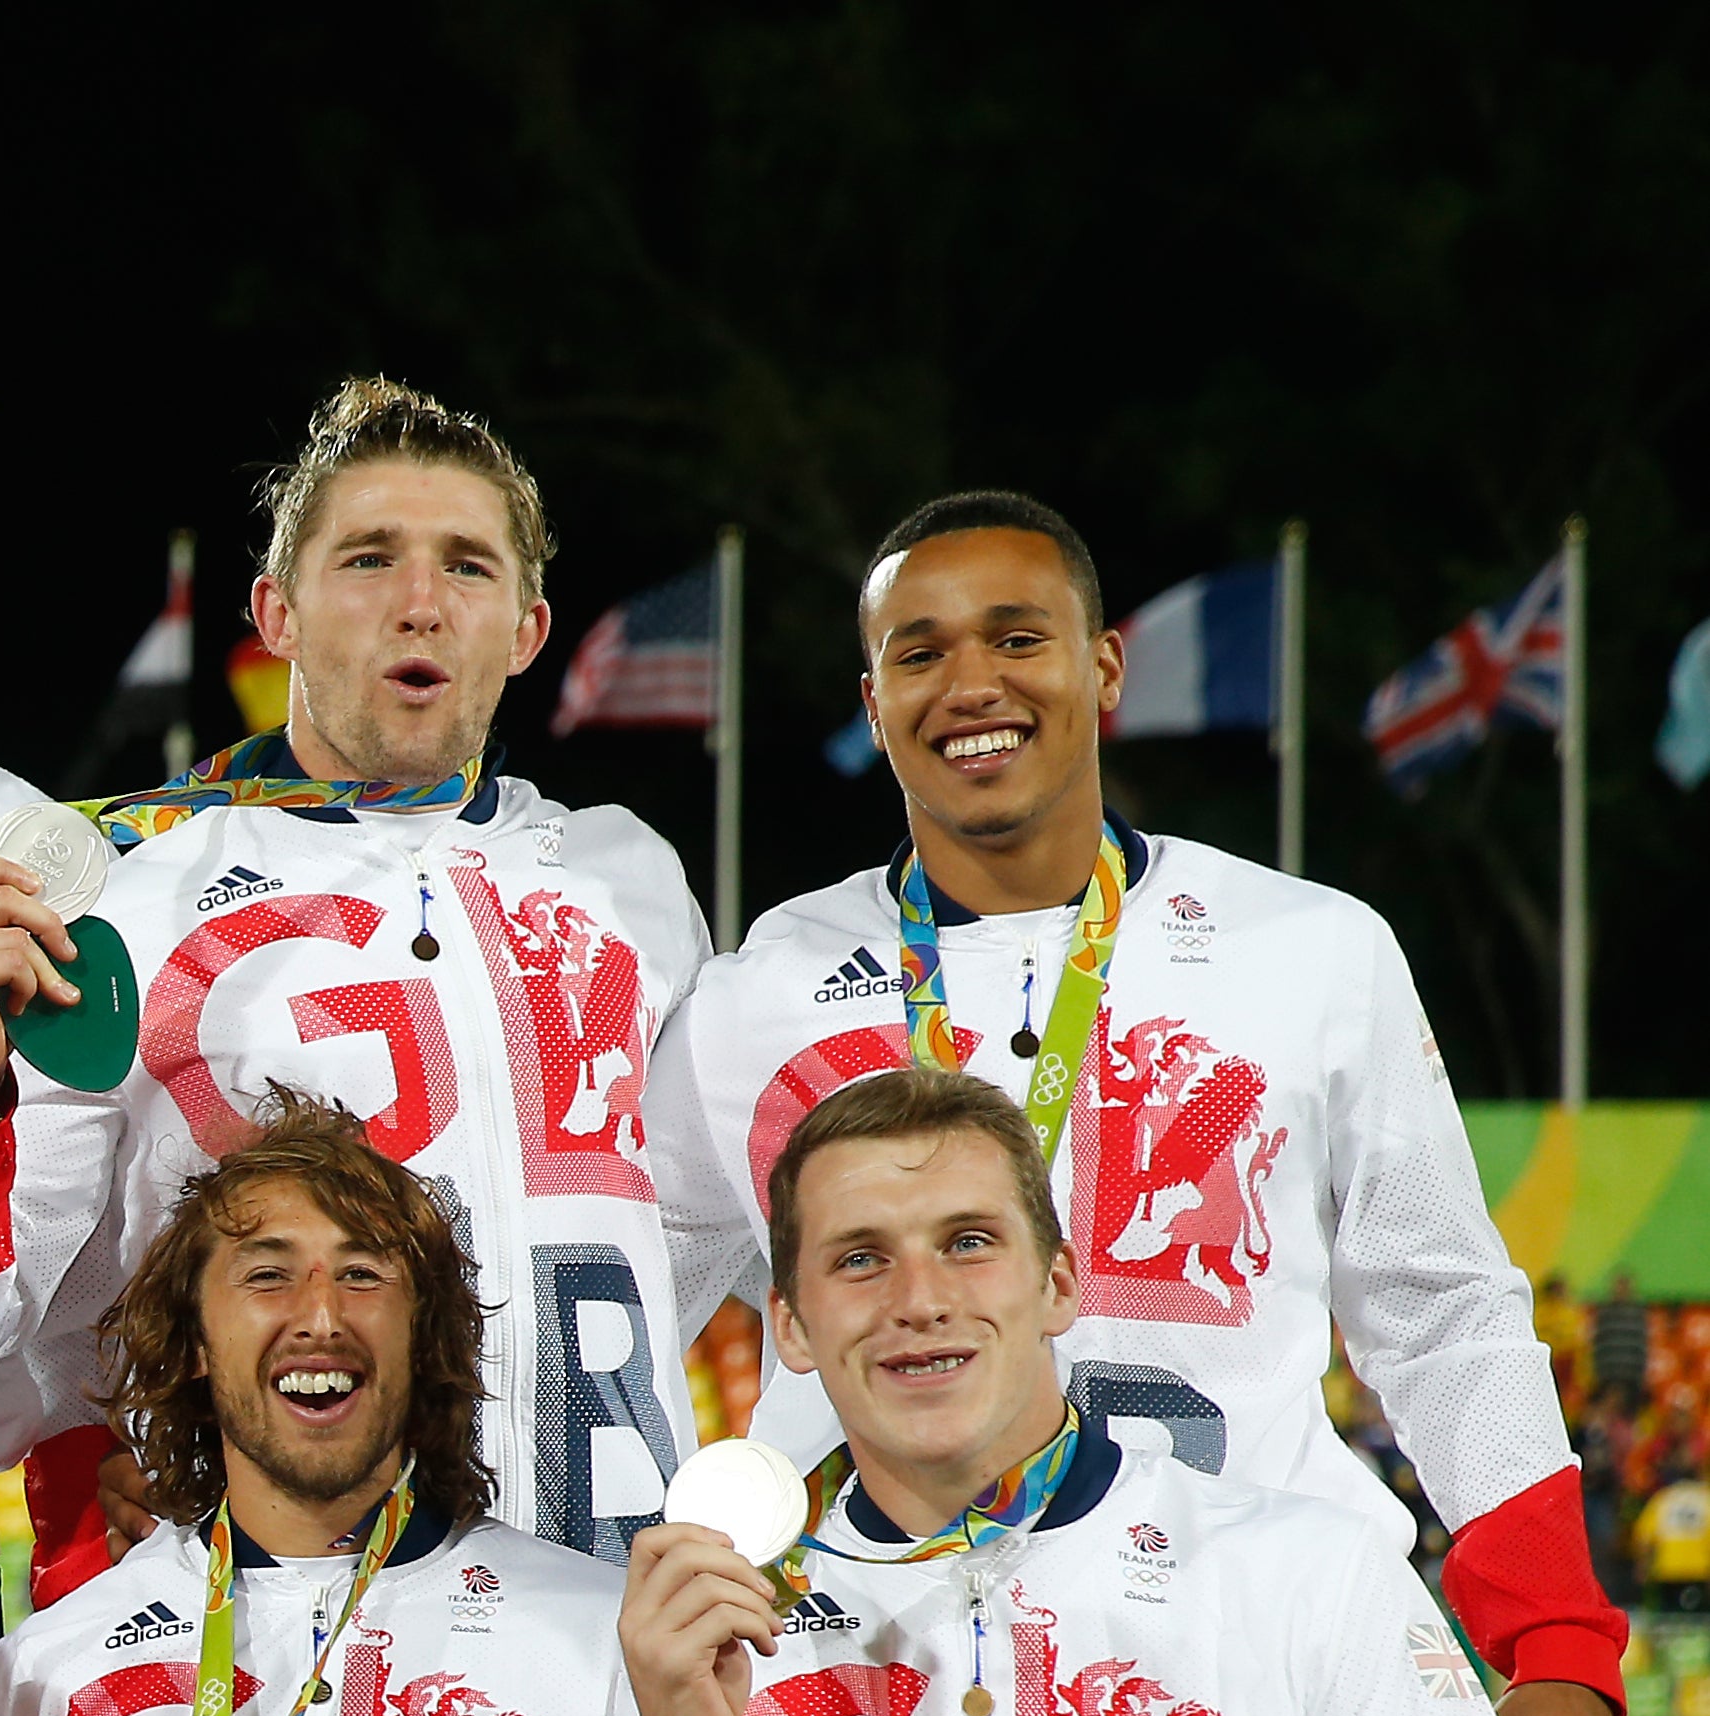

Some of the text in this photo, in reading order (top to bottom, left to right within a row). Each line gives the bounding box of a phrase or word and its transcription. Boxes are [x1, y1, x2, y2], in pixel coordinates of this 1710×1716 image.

[196, 877, 284, 912] adidas
[1160, 920, 1218, 934] TEAM GB
[1170, 954, 1211, 965] Rio2016
[814, 974, 903, 1004] adidas
[1118, 1549, 1178, 1569] TEAM GB
[446, 1594, 505, 1604] TEAM GB
[1123, 1590, 1169, 1604] Rio2016
[105, 1618, 194, 1651] adidas
[449, 1624, 494, 1634] Rio2016
[784, 1615, 861, 1637] didas
